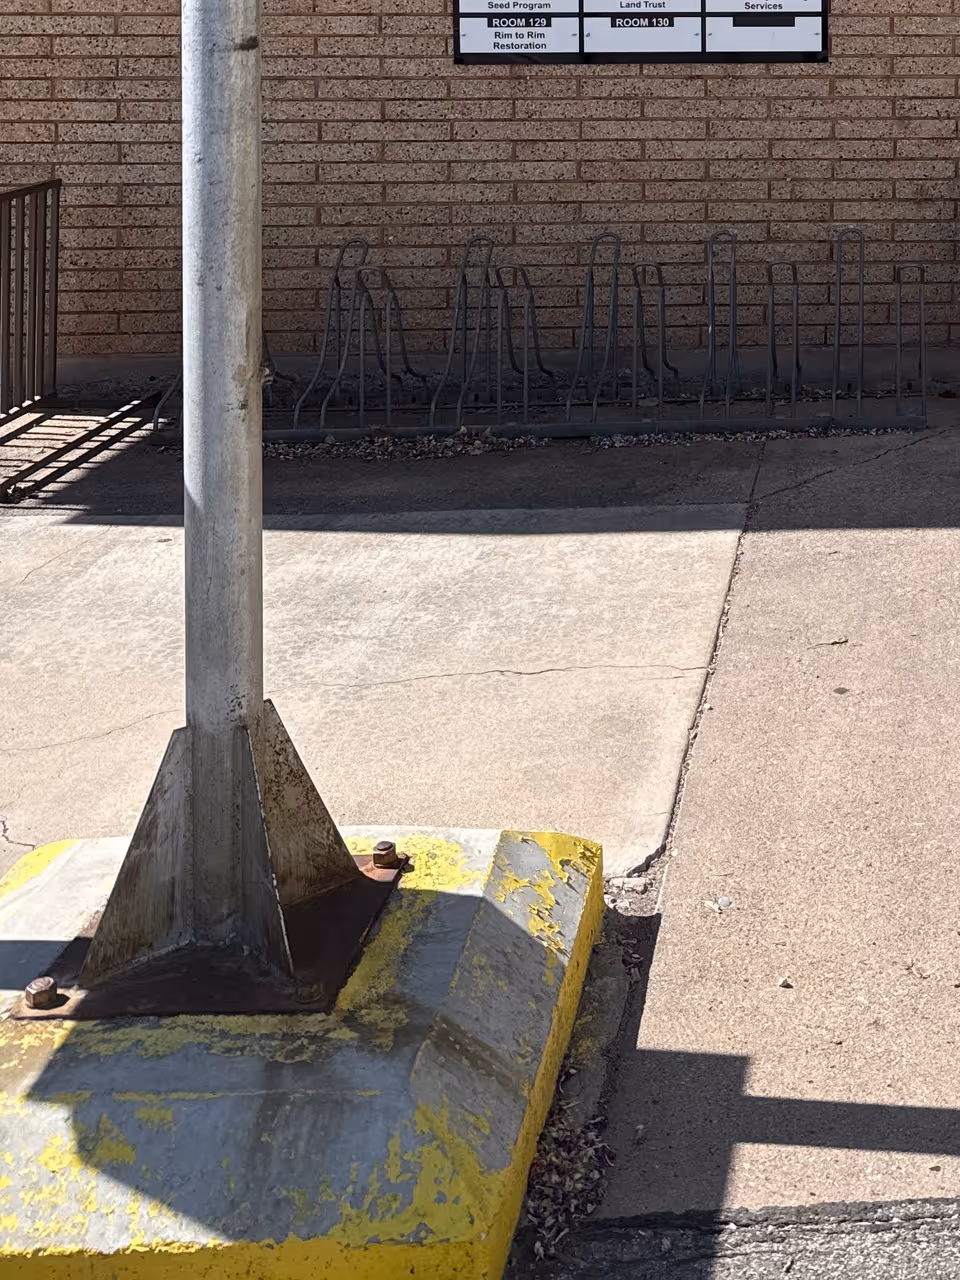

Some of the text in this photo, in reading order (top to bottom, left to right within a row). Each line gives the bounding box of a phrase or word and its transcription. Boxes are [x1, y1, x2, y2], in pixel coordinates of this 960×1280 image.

[513, 2, 550, 10] Program
[493, 18, 546, 26] ROOM 129
[616, 18, 669, 26] ROOM 130
